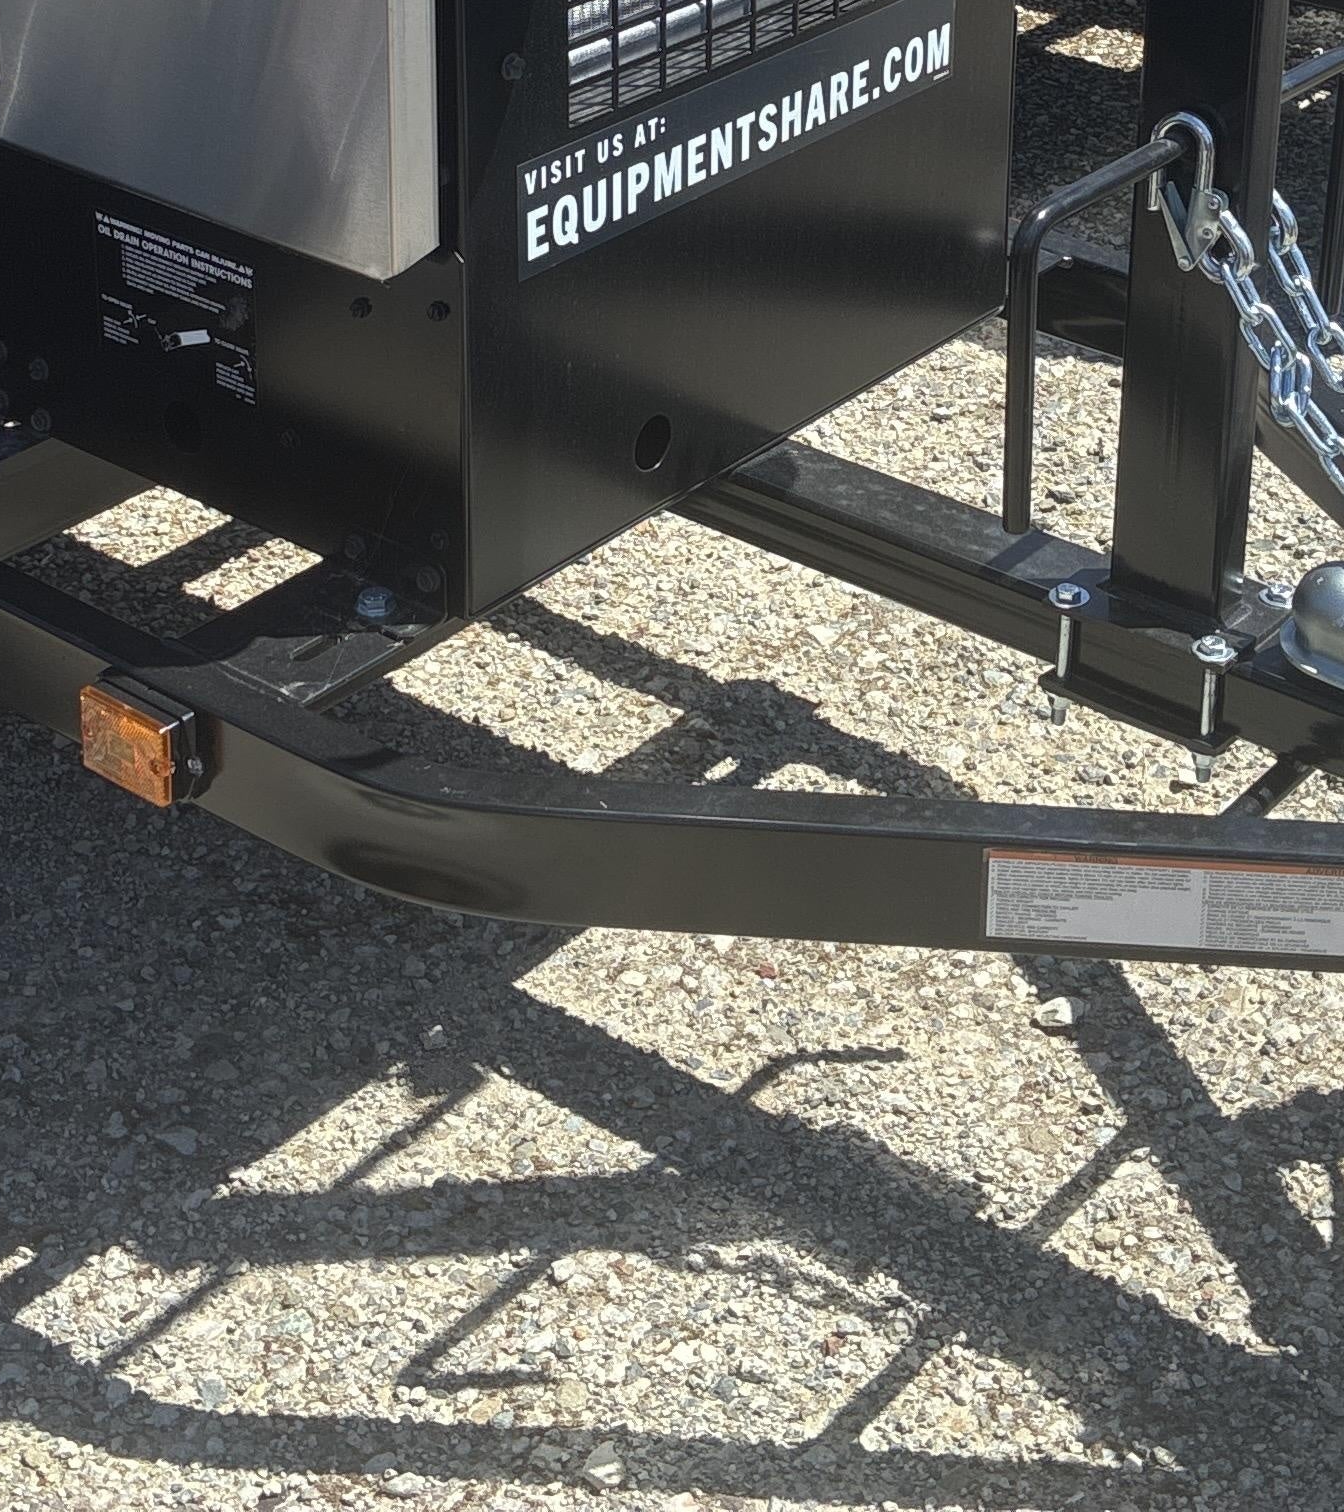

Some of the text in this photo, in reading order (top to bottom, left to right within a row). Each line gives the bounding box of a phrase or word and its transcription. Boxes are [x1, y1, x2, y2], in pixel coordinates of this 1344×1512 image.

[523, 115, 667, 195] VISIT US AT:
[526, 22, 951, 262] EQUIPMENTSHARE.COM
[97, 224, 254, 289] OIL DRAIN OPERATION INSTRUCTIONS
